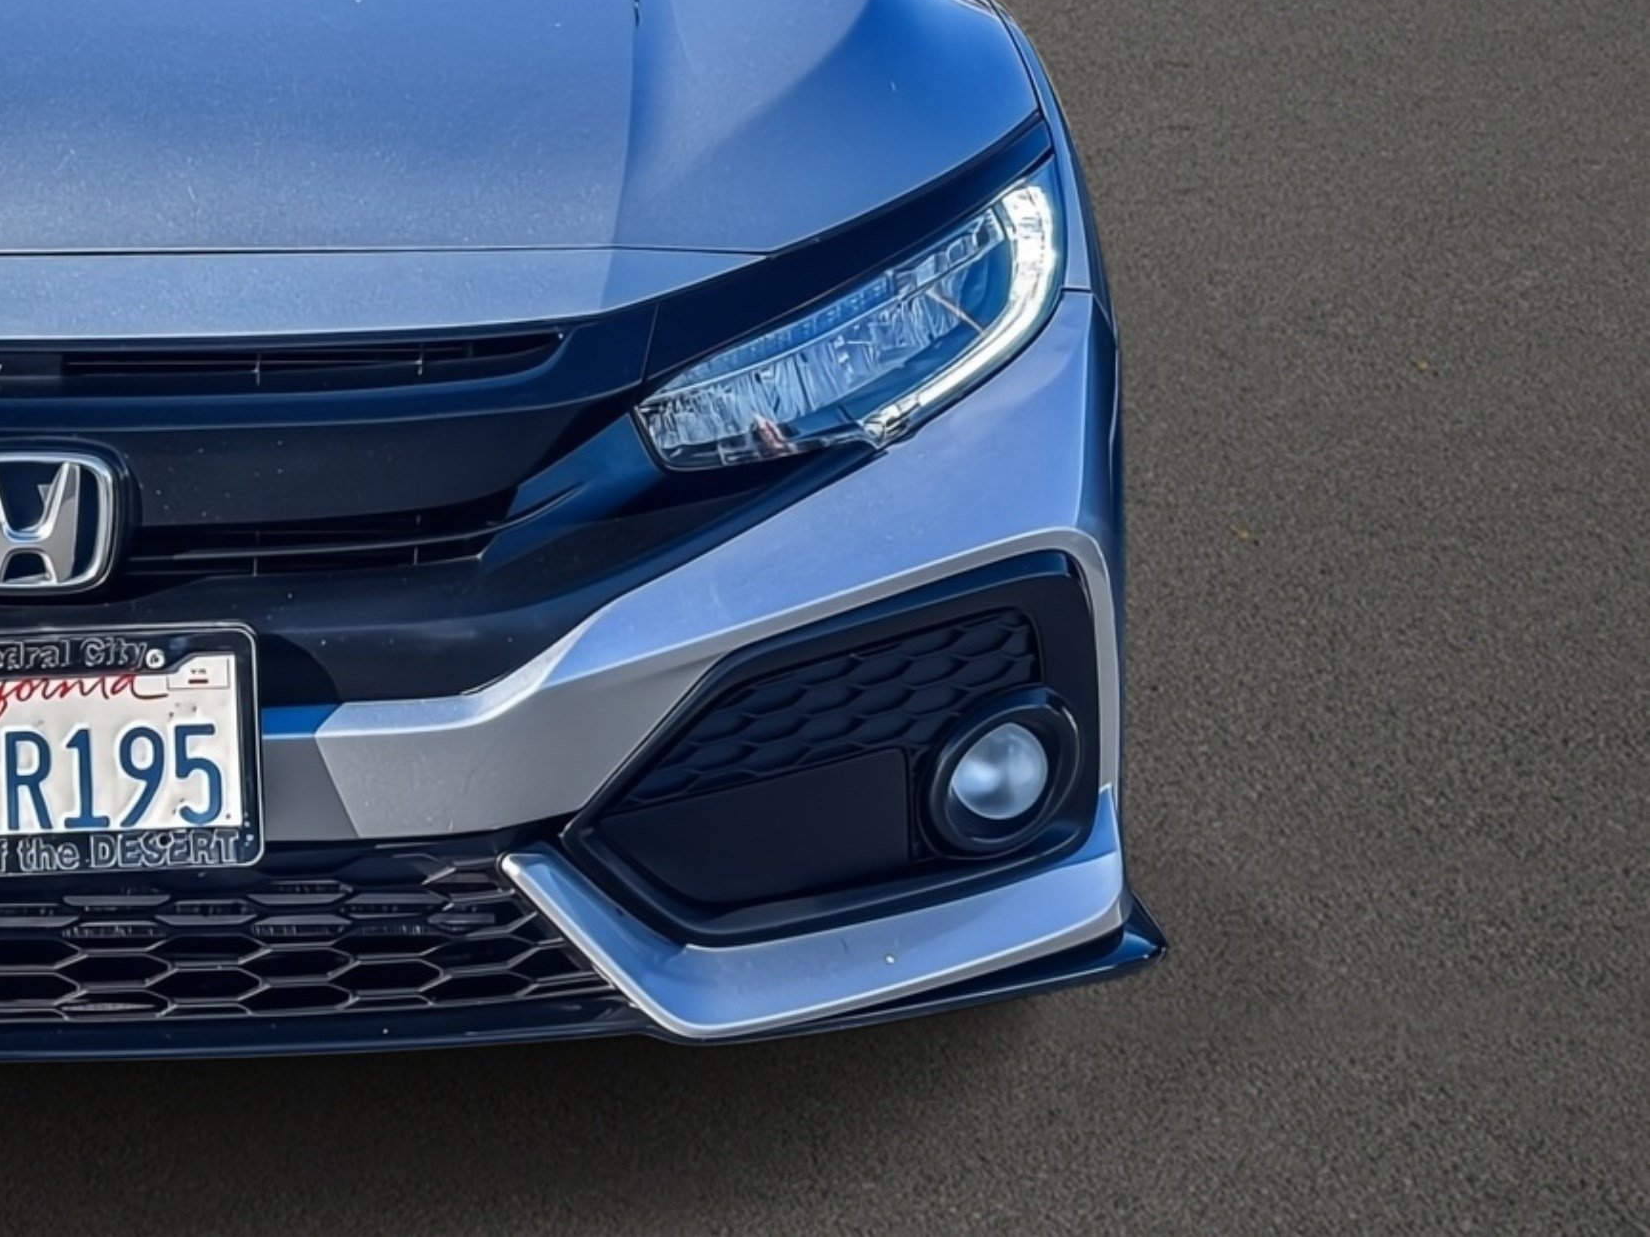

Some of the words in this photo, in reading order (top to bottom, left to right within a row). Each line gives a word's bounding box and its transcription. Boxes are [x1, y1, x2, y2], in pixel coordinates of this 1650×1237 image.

[81, 635, 149, 669] City
[17, 837, 80, 873] the
[89, 830, 242, 869] DESERT
